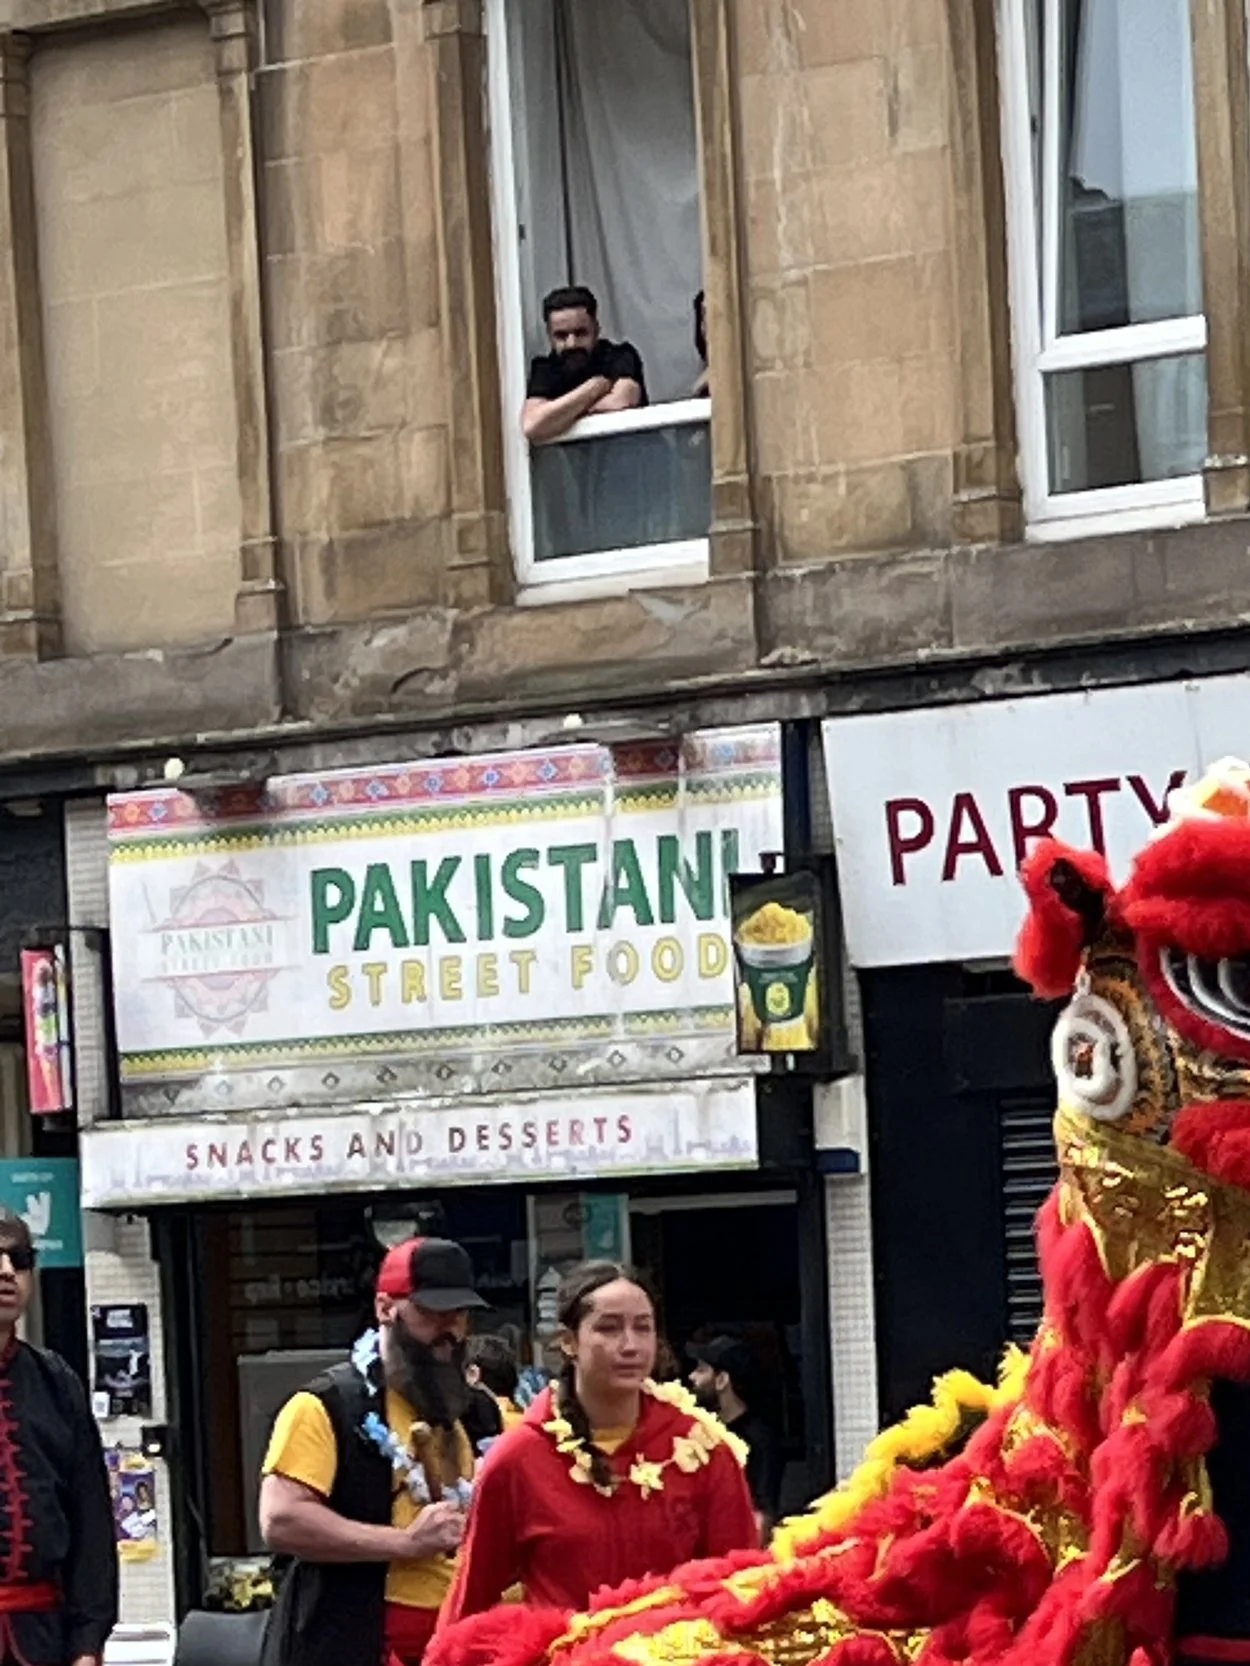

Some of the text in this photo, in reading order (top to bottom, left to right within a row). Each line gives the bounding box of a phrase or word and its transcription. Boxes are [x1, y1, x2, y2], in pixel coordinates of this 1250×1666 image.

[885, 770, 1187, 886] PARTY
[311, 829, 739, 954] PAKISTANI
[327, 933, 728, 1010] STREET FOOD
[186, 1115, 633, 1170] SNACKS AND DESSERTS
